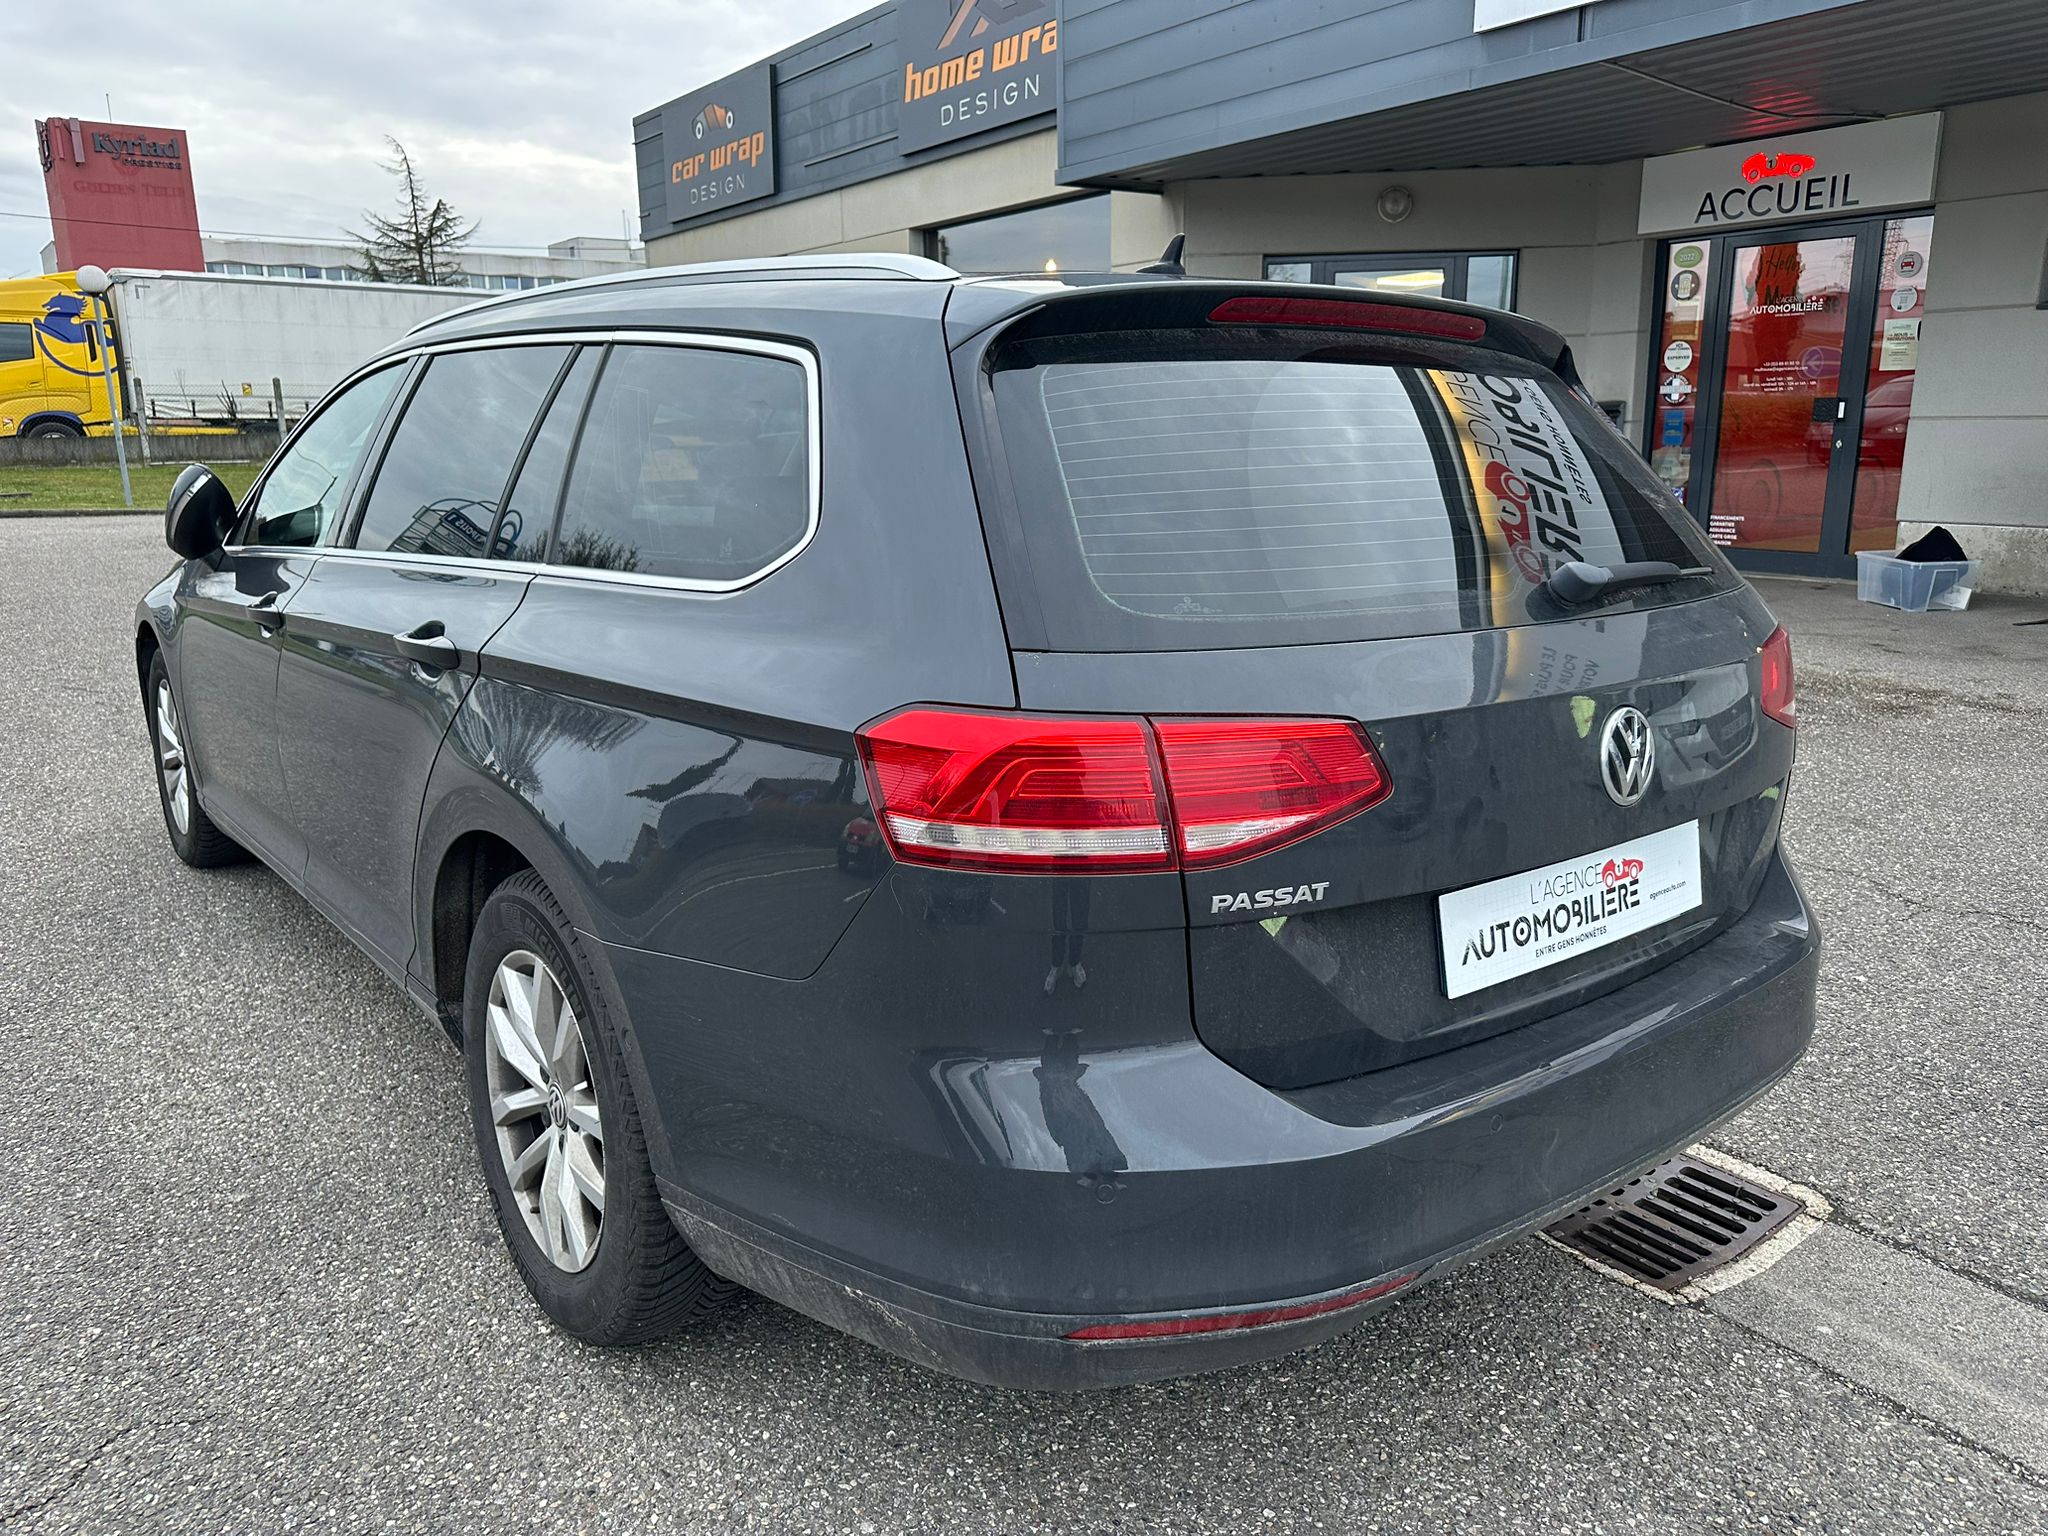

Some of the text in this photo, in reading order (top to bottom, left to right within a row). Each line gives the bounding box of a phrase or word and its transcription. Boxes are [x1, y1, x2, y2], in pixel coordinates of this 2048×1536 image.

[904, 19, 1057, 104] home wra
[940, 74, 1040, 127] DESIGN
[92, 131, 181, 160] Kyriad
[672, 131, 765, 184] car wrap
[690, 173, 746, 205] DESIGN
[1694, 173, 1860, 224] ACCUEIL
[1210, 881, 1330, 914] PASSAT
[1529, 861, 1603, 905] L'AGENCE
[1649, 879, 1687, 900] agenceauto.com
[1535, 924, 1608, 958] ENTRE GENS HONNÊTES
